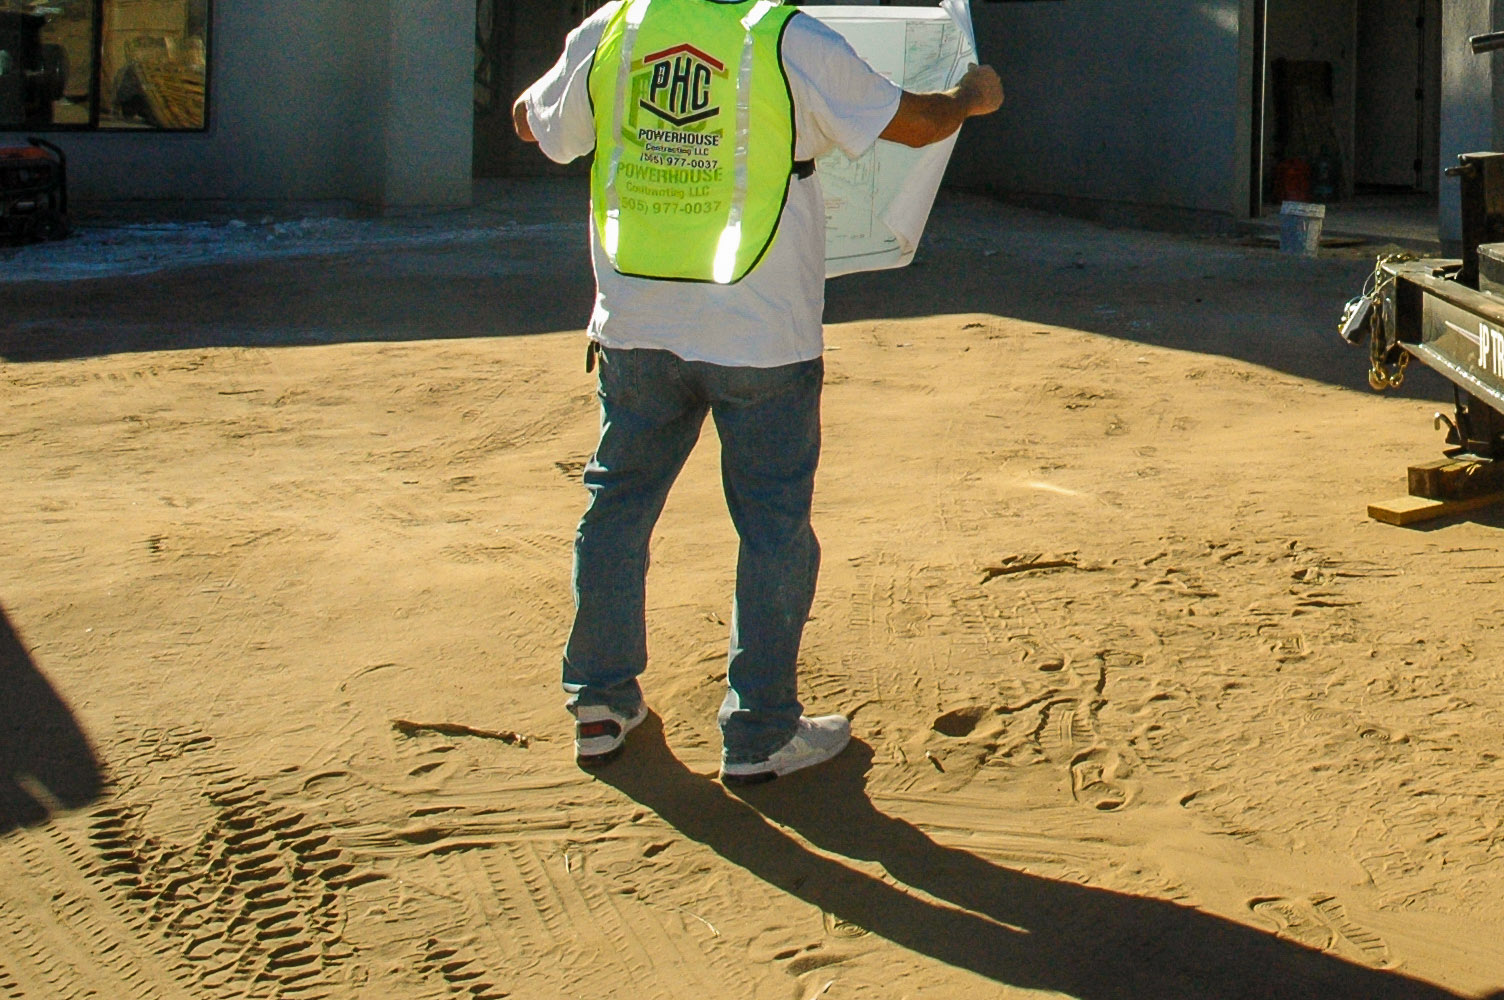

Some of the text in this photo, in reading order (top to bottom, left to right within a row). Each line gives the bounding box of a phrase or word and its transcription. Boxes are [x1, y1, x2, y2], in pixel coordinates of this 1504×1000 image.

[650, 56, 712, 114] PHC
[638, 128, 719, 146] POWERHOUSE
[694, 147, 709, 156] LLC
[666, 156, 718, 169] 977-0037
[1478, 322, 1490, 370] JP
